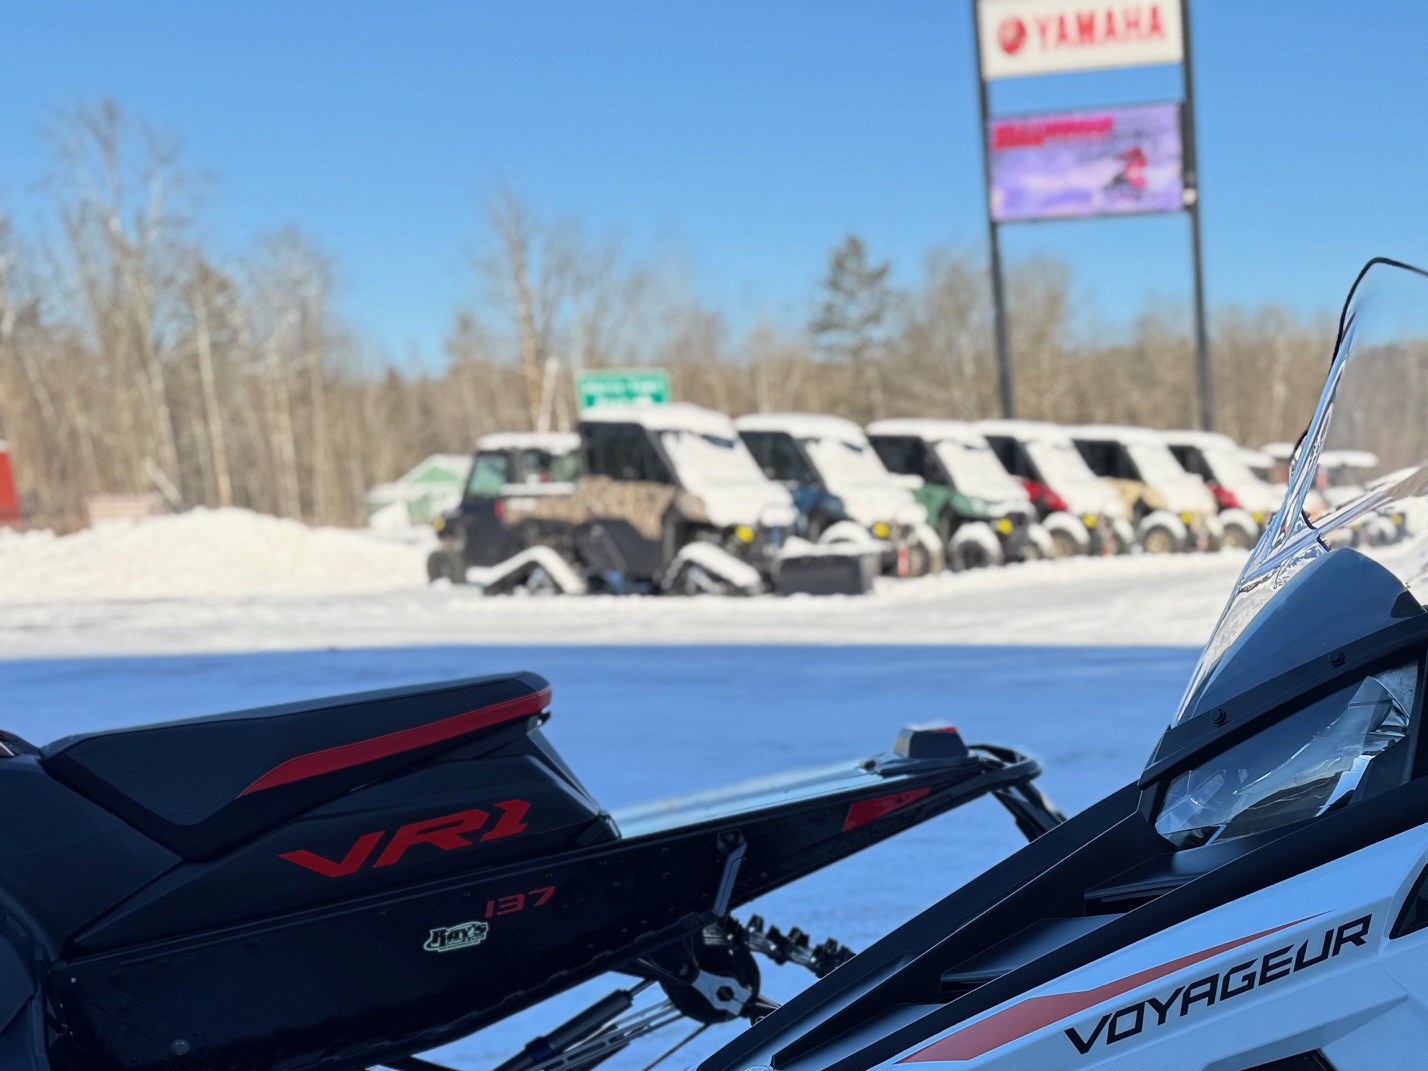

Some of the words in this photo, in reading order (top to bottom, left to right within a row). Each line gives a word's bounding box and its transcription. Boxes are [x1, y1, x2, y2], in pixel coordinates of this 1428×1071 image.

[1034, 5, 1163, 49] YAMAHA
[277, 799, 532, 878] VR1
[485, 886, 556, 918] 137
[1064, 913, 1373, 1056] VOYAGEUR
